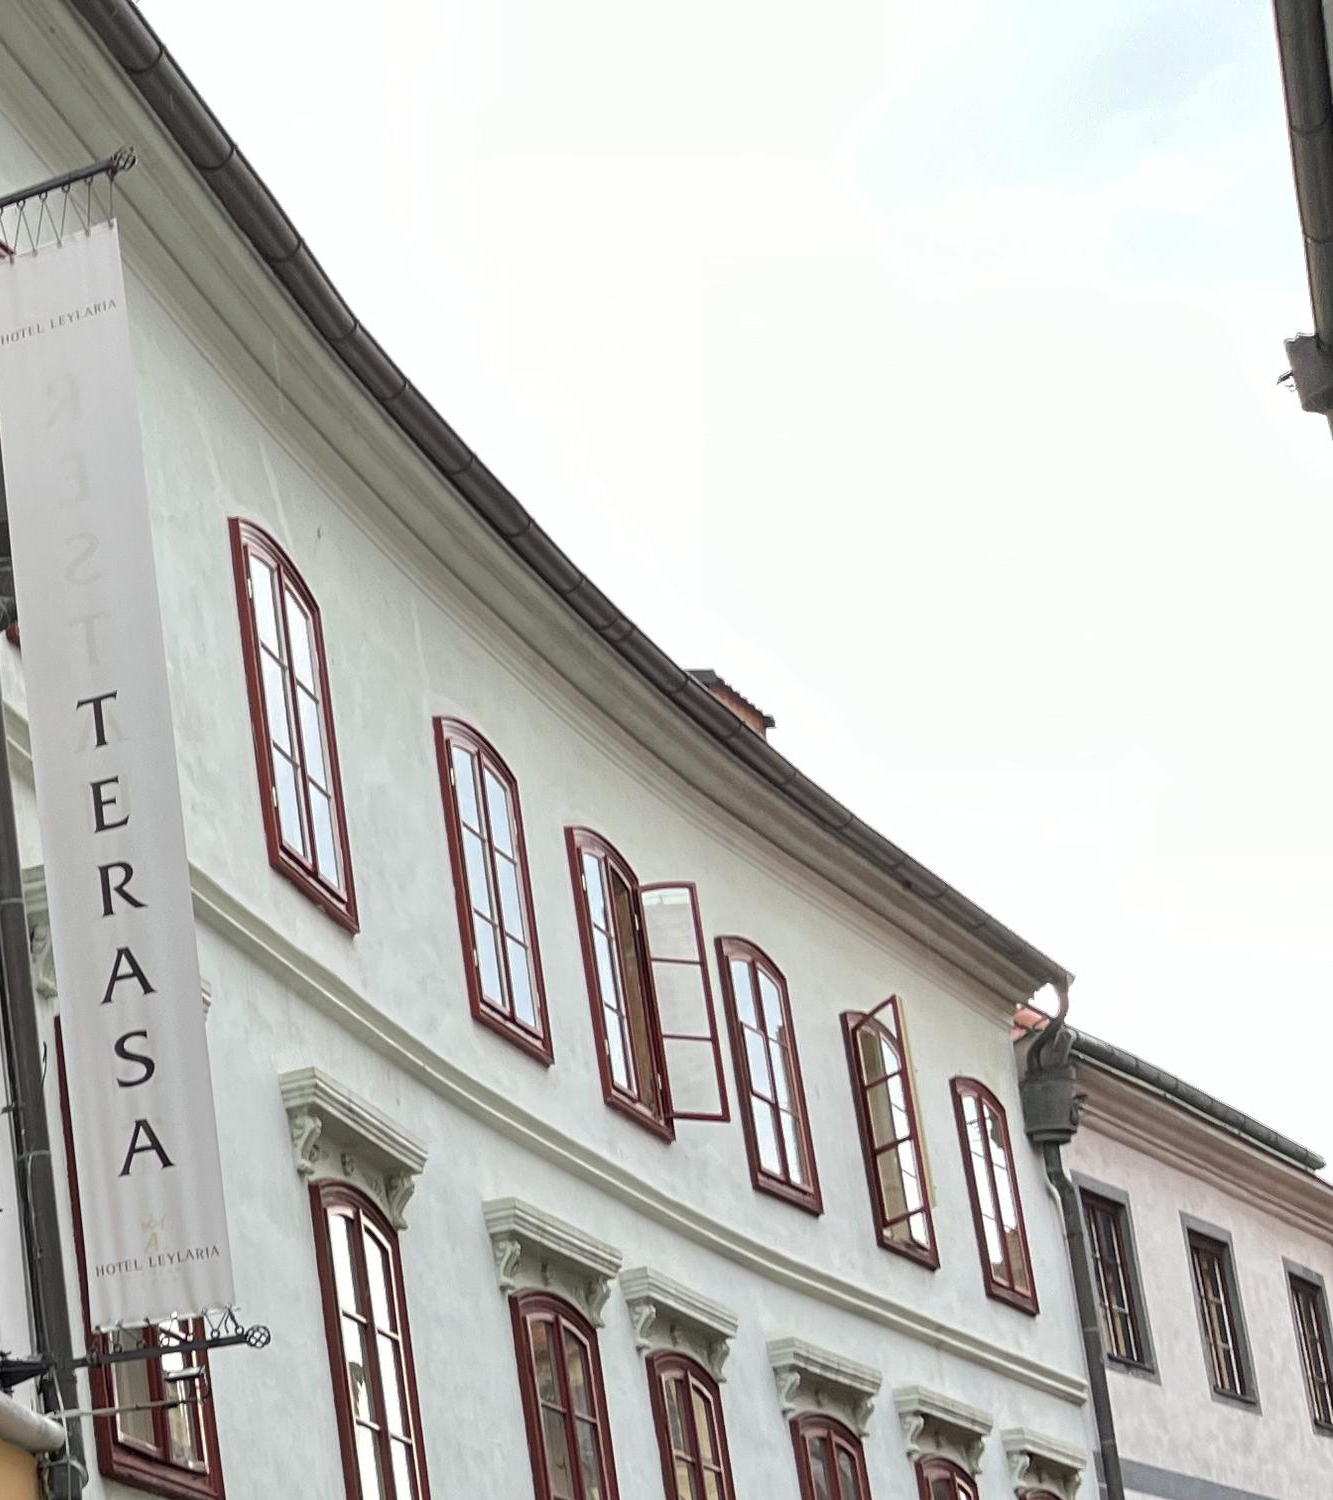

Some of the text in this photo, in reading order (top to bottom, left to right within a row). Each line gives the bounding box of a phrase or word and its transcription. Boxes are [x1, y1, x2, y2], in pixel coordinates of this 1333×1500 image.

[1, 299, 117, 345] HOTEL LEYLARIA
[76, 689, 176, 1179] TERASA
[95, 1244, 220, 1278] HOTEL LEYLARIA
